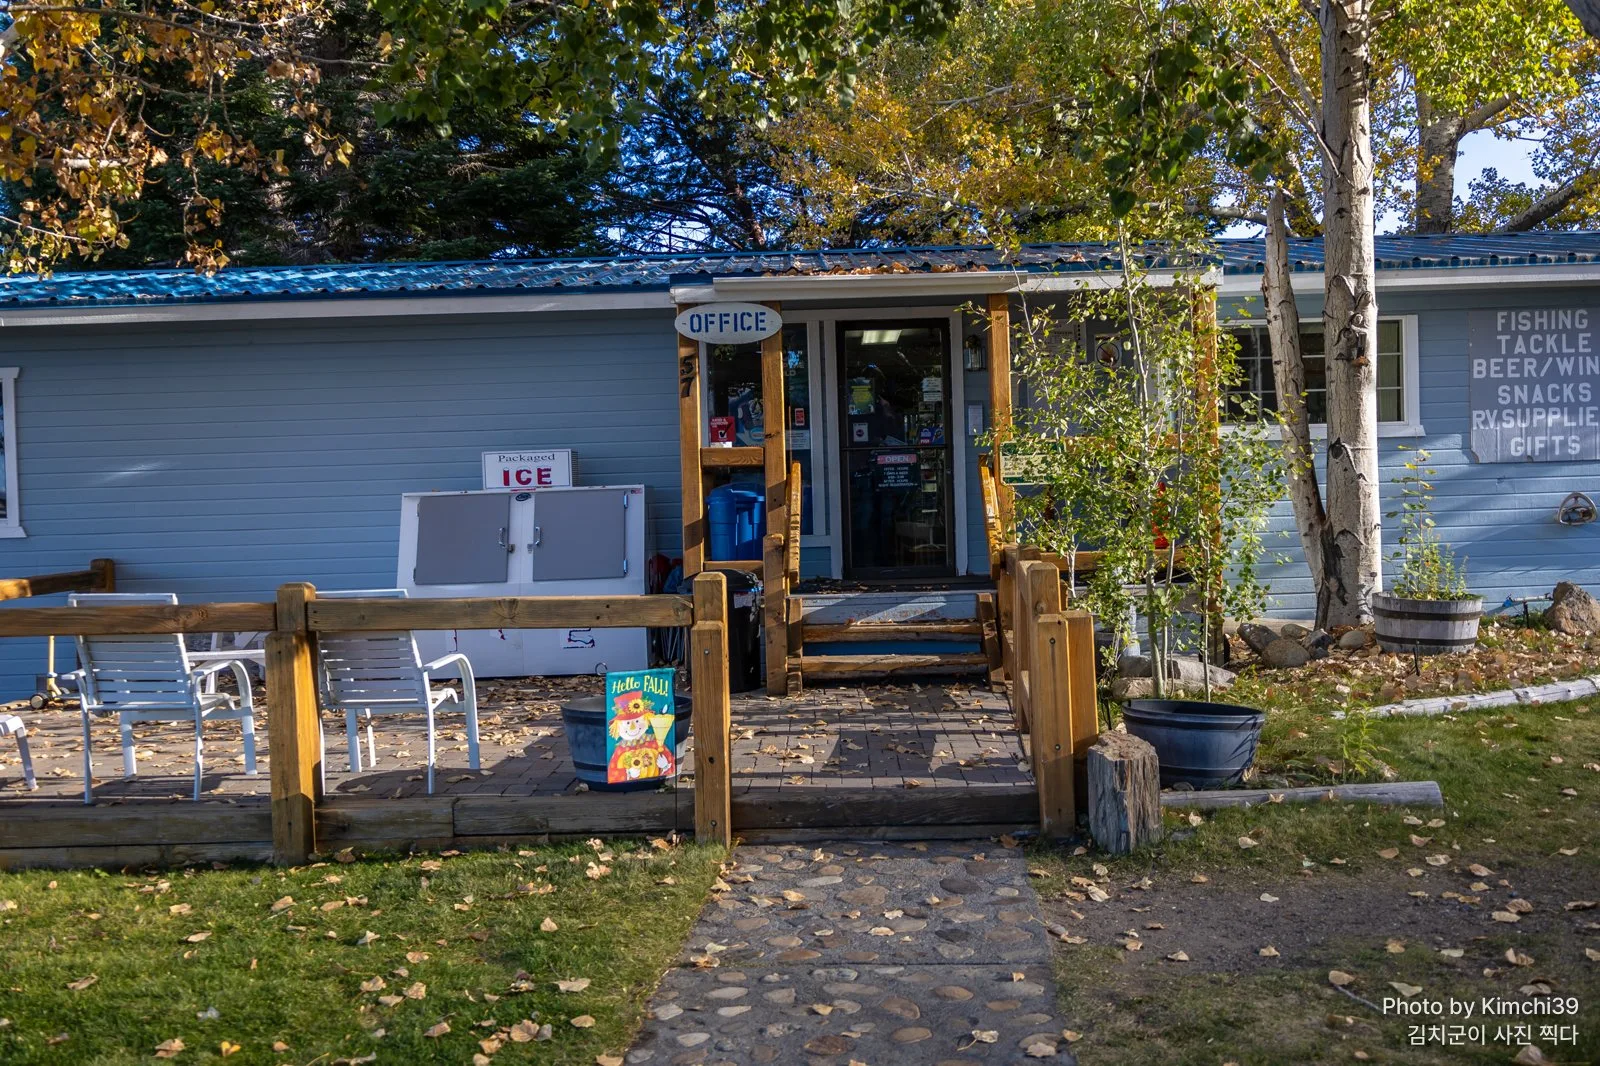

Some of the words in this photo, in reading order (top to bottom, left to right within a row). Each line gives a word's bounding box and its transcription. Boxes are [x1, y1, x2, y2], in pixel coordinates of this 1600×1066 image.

[690, 312, 767, 333] OFFICE
[1497, 309, 1589, 331] FISHING
[1496, 332, 1592, 355] TACKLE
[1497, 382, 1592, 405] SNACKS
[1510, 435, 1581, 456] GIFTS
[498, 453, 556, 463] Packaged
[502, 467, 553, 486] ICE
[611, 676, 641, 694] Hello
[643, 674, 669, 697] FALL!
